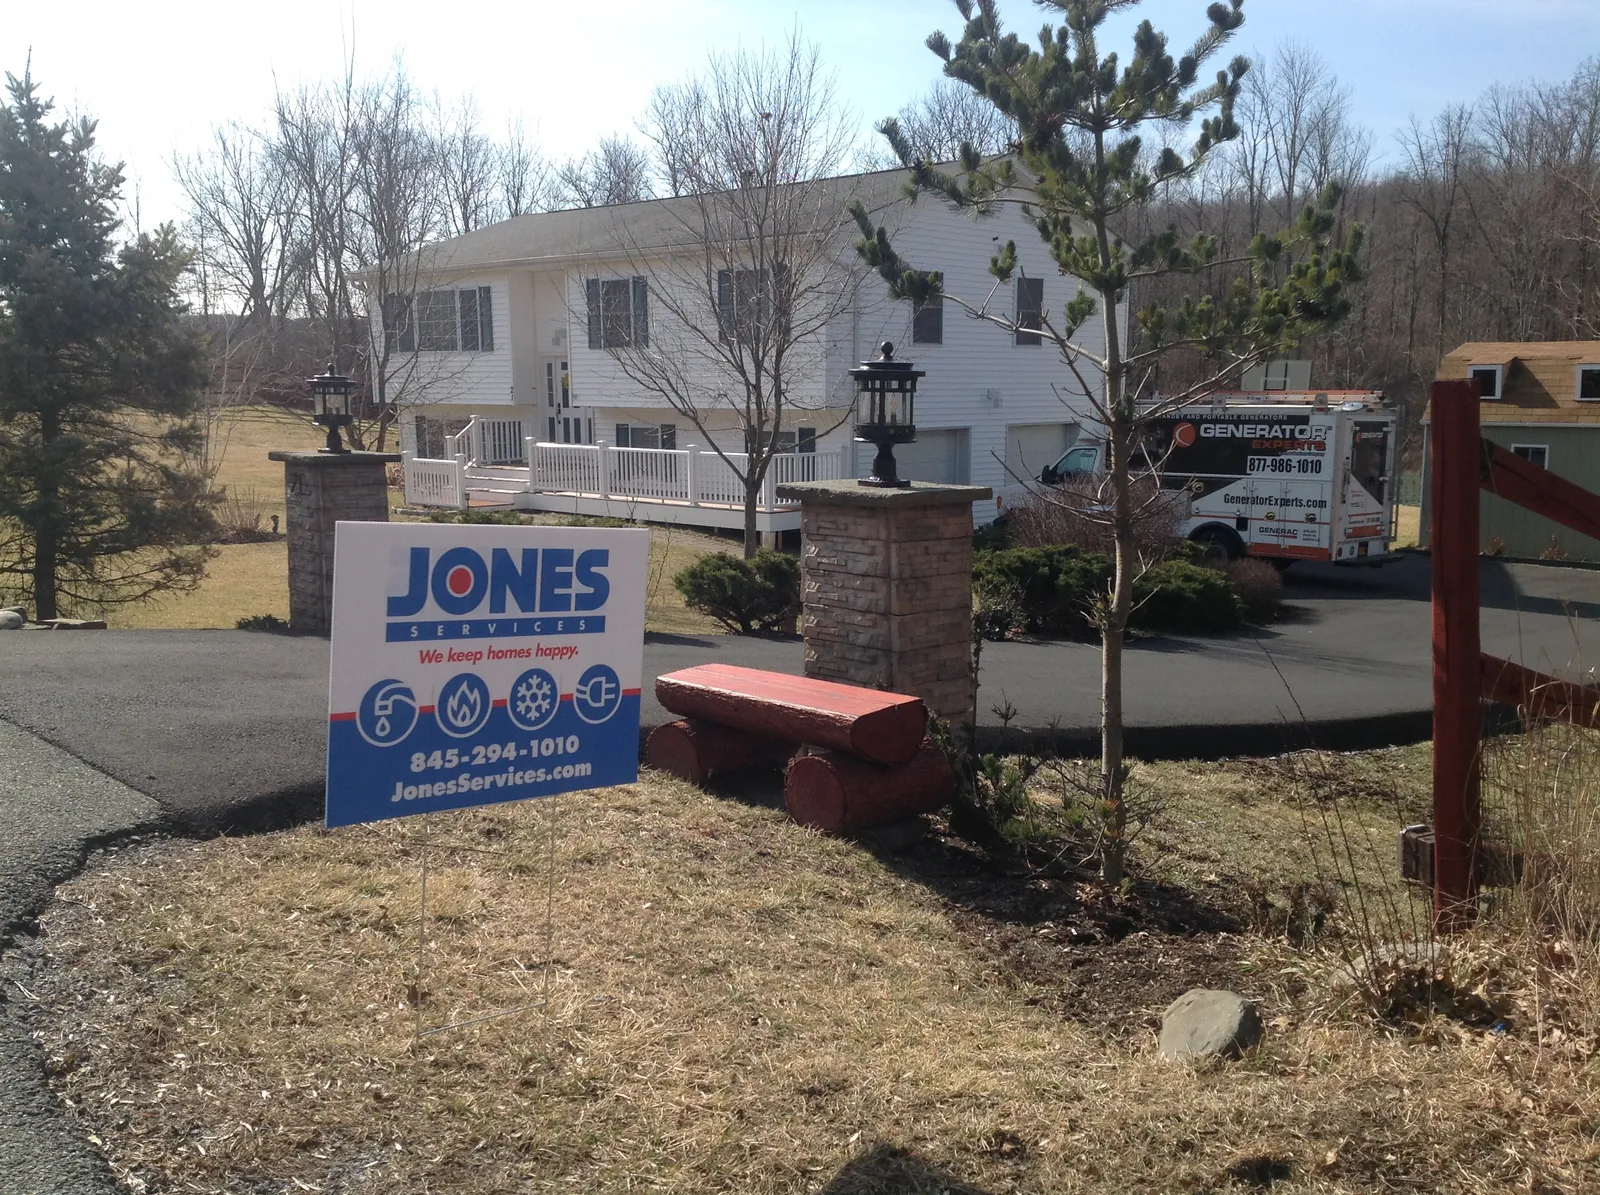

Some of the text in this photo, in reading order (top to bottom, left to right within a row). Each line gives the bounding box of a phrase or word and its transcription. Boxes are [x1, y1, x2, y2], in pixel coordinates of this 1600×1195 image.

[1200, 423, 1327, 440] GENERATOR
[1252, 439, 1326, 451] EXPERTS
[1248, 457, 1322, 474] 877-986-1010
[1223, 493, 1327, 509] GeneratorExperts.com
[1258, 526, 1299, 535] GENERAC
[386, 546, 611, 617] JONES
[410, 619, 586, 637] SERVICES
[418, 642, 579, 665] We keep homes happy.
[410, 735, 580, 773] 845-294-1010
[391, 760, 592, 803] JonesServices.com
